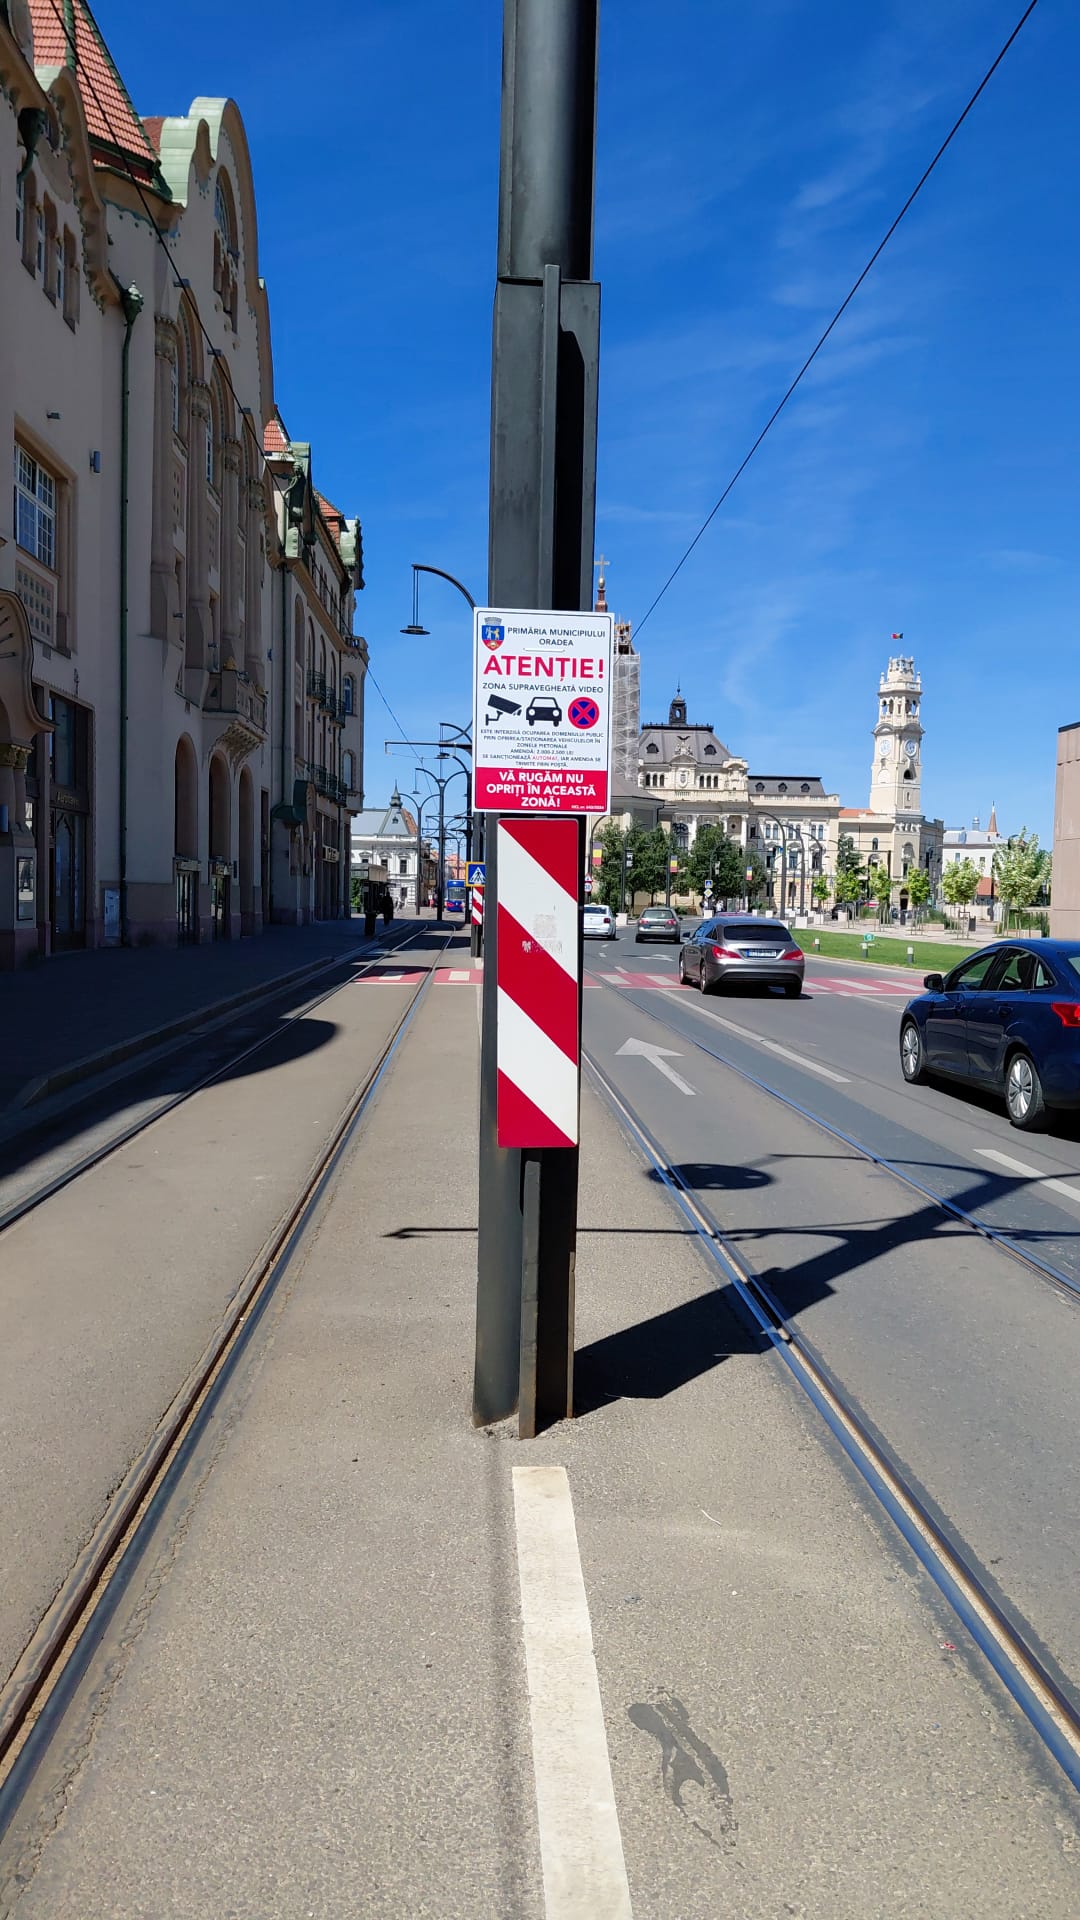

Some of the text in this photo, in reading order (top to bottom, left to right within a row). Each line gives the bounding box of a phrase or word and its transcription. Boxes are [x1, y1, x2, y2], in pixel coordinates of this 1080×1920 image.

[508, 626, 605, 637] PRIMĂRIA MUNICIPIULUI
[483, 655, 604, 682] ATENȚIE!
[509, 684, 576, 692] SUPRAVEGHEATĂ
[579, 685, 604, 693] VIDEO
[499, 770, 584, 783] VĂ RUGĂM NU
[486, 782, 596, 797] OPRIȚI ÎN ACEASTĂ
[521, 796, 560, 807] ZONĂ!
